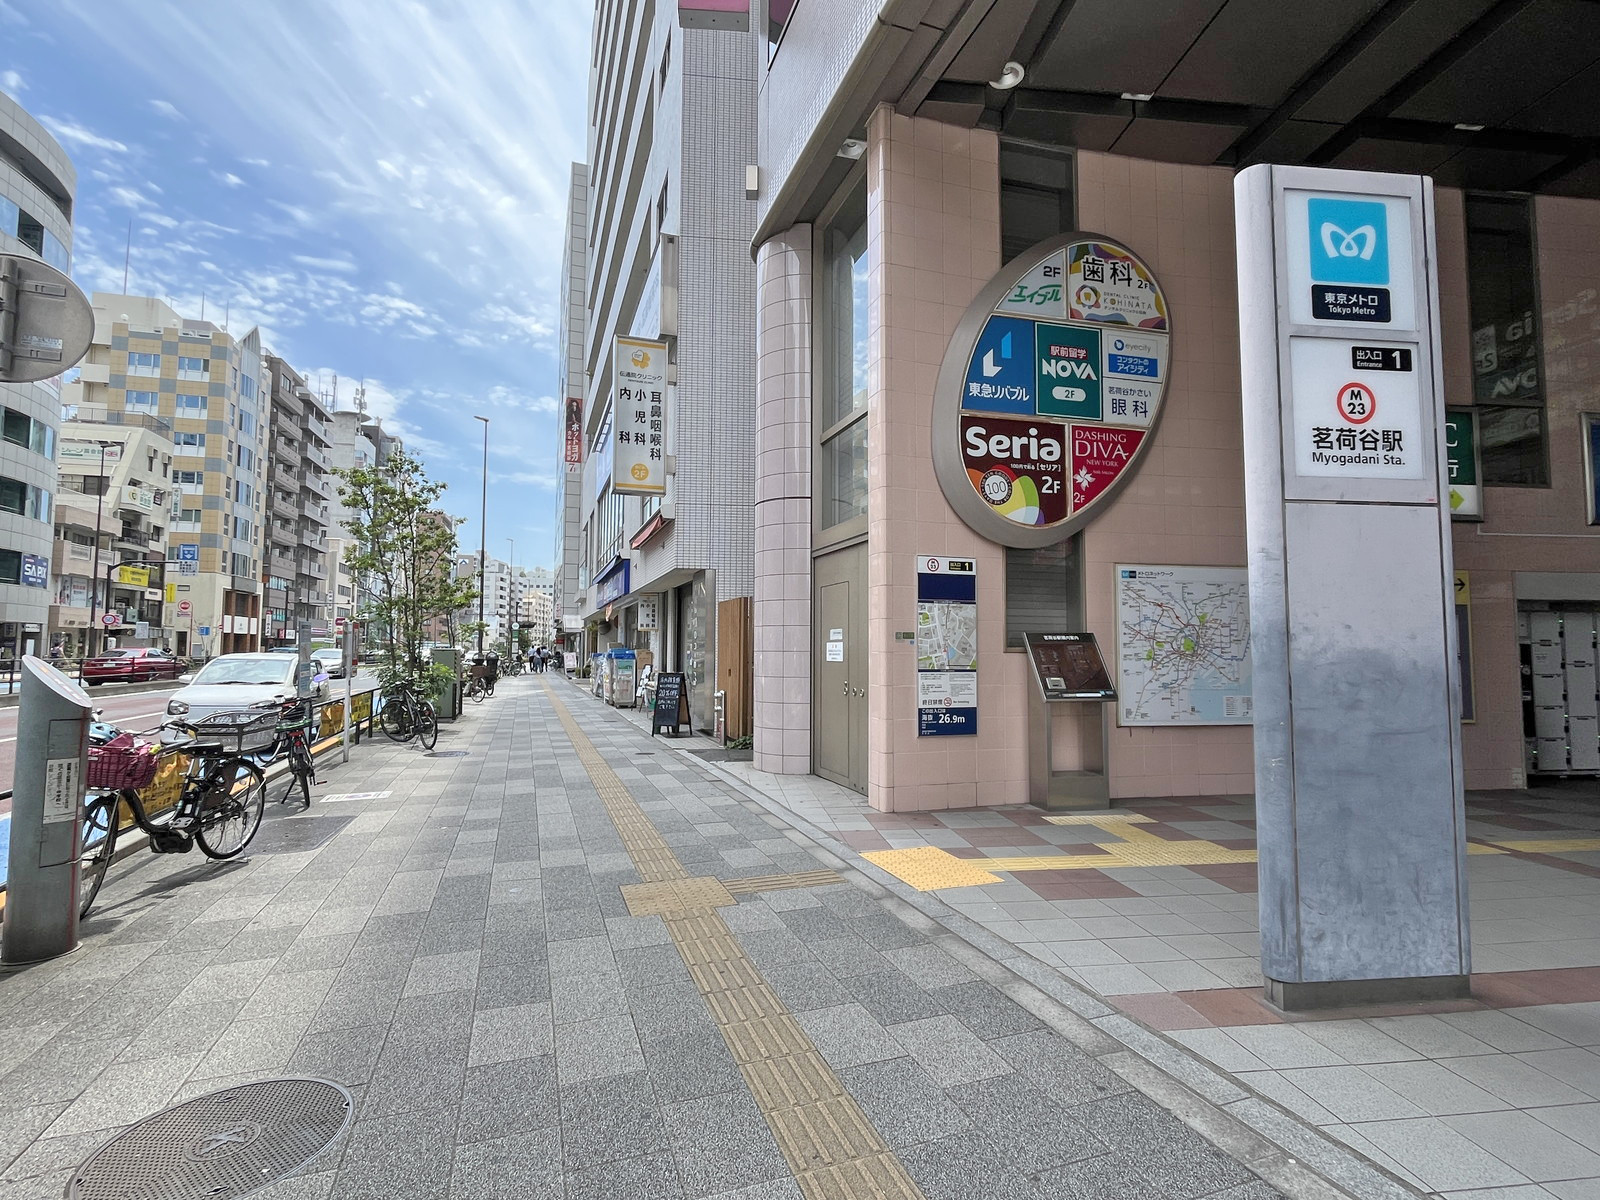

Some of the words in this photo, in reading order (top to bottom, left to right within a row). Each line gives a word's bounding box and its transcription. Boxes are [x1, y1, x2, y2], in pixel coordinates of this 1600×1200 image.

[1043, 265, 1061, 278] 2F
[1082, 257, 1132, 287] 歯科
[1137, 280, 1149, 289] 2F
[1008, 284, 1062, 305] エイブル
[1324, 292, 1378, 306] 東京メトロ
[1328, 305, 1351, 315] Tokyo
[1352, 306, 1376, 316] Metro
[1050, 345, 1088, 359] 駅前留学
[1125, 343, 1151, 353] eyecity
[1356, 350, 1382, 360] 出入口
[1391, 350, 1401, 369] 1
[1356, 360, 1383, 369] Entrance
[1042, 358, 1097, 381] NOVA
[1117, 363, 1149, 374] アイシティ
[968, 381, 1030, 401] 東急リバブル
[1064, 389, 1076, 399] 2F
[1350, 390, 1363, 401] M
[1111, 398, 1149, 418] 眼科
[1347, 403, 1366, 415] 23
[619, 386, 631, 445] 内科
[633, 388, 647, 446] 小児科
[649, 391, 662, 461] 耳鼻咽喉科
[1075, 429, 1127, 443] DASHING
[1311, 427, 1404, 452] 茗荷谷駅
[965, 426, 1062, 462] Seria
[1075, 440, 1129, 460] DIVA
[1312, 452, 1380, 466] Myogadani
[1383, 454, 1406, 466] Sta.
[986, 481, 1007, 495] 100
[1041, 475, 1061, 494] 2F
[1073, 492, 1085, 503] 2F
[964, 562, 969, 571] 1
[938, 713, 966, 724] 26.9m
